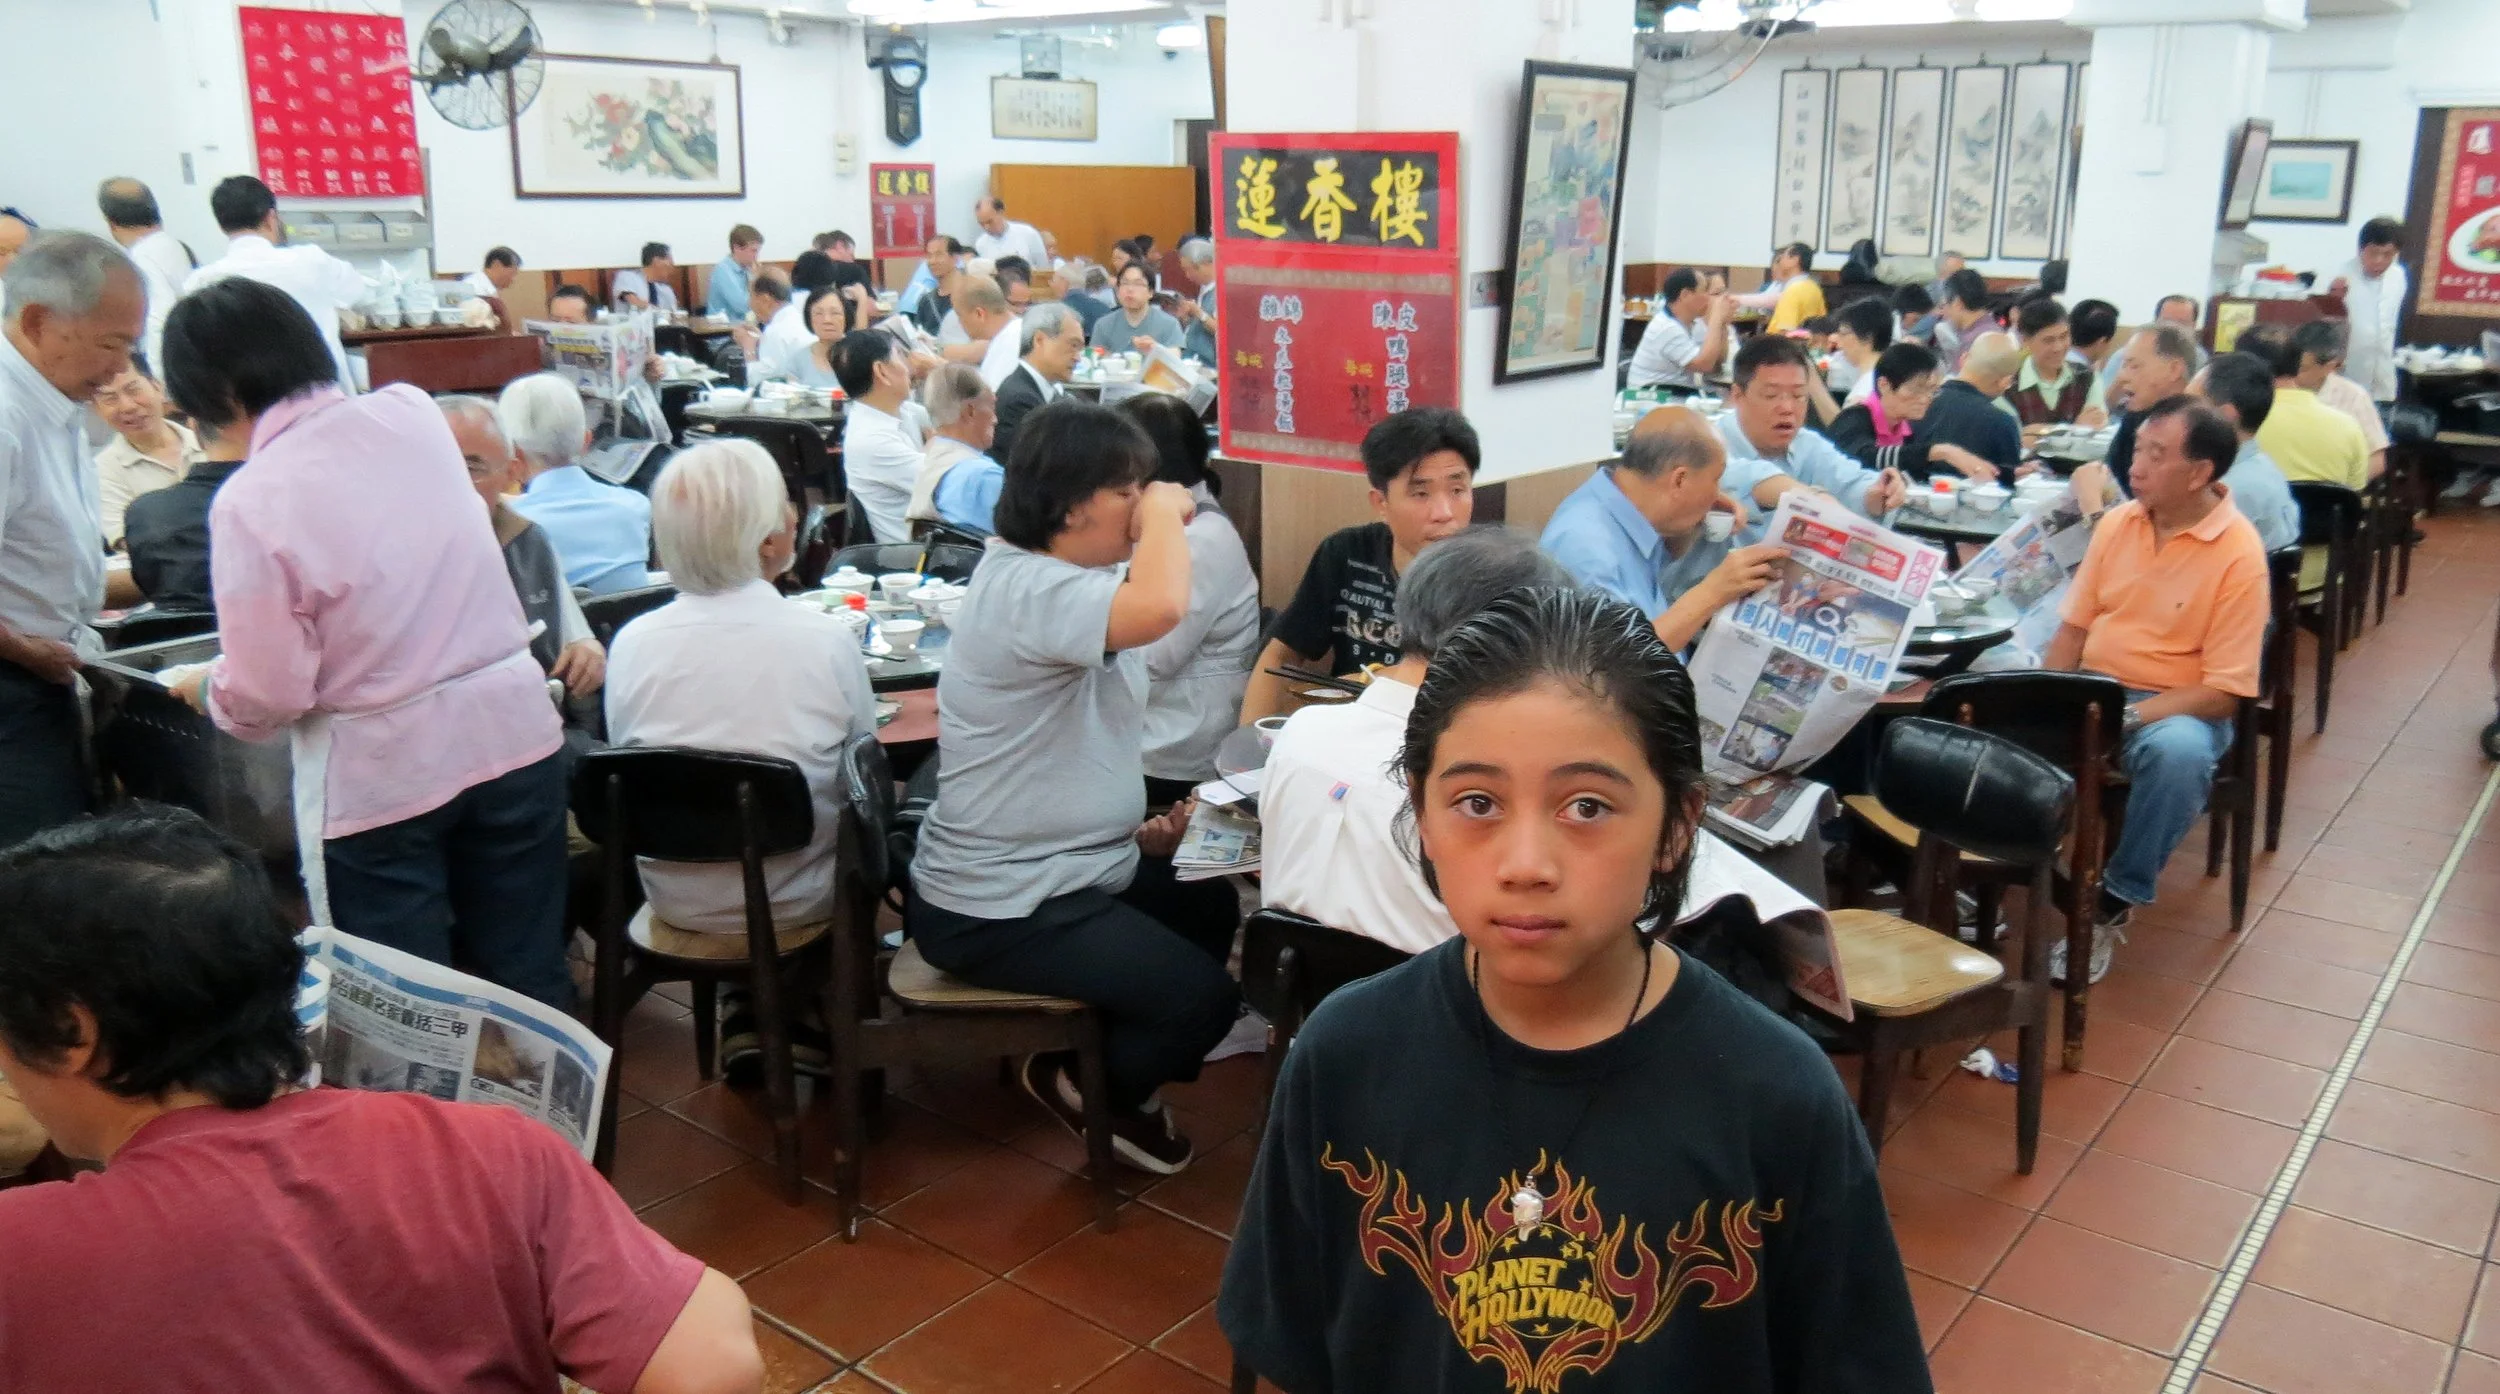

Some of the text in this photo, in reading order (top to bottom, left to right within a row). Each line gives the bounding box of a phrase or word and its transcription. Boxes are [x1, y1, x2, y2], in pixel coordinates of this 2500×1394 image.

[1236, 156, 1429, 246] 蓮香樓
[1452, 1257, 1567, 1319] PLANET
[1461, 1286, 1616, 1349] HOLLYWOOD
